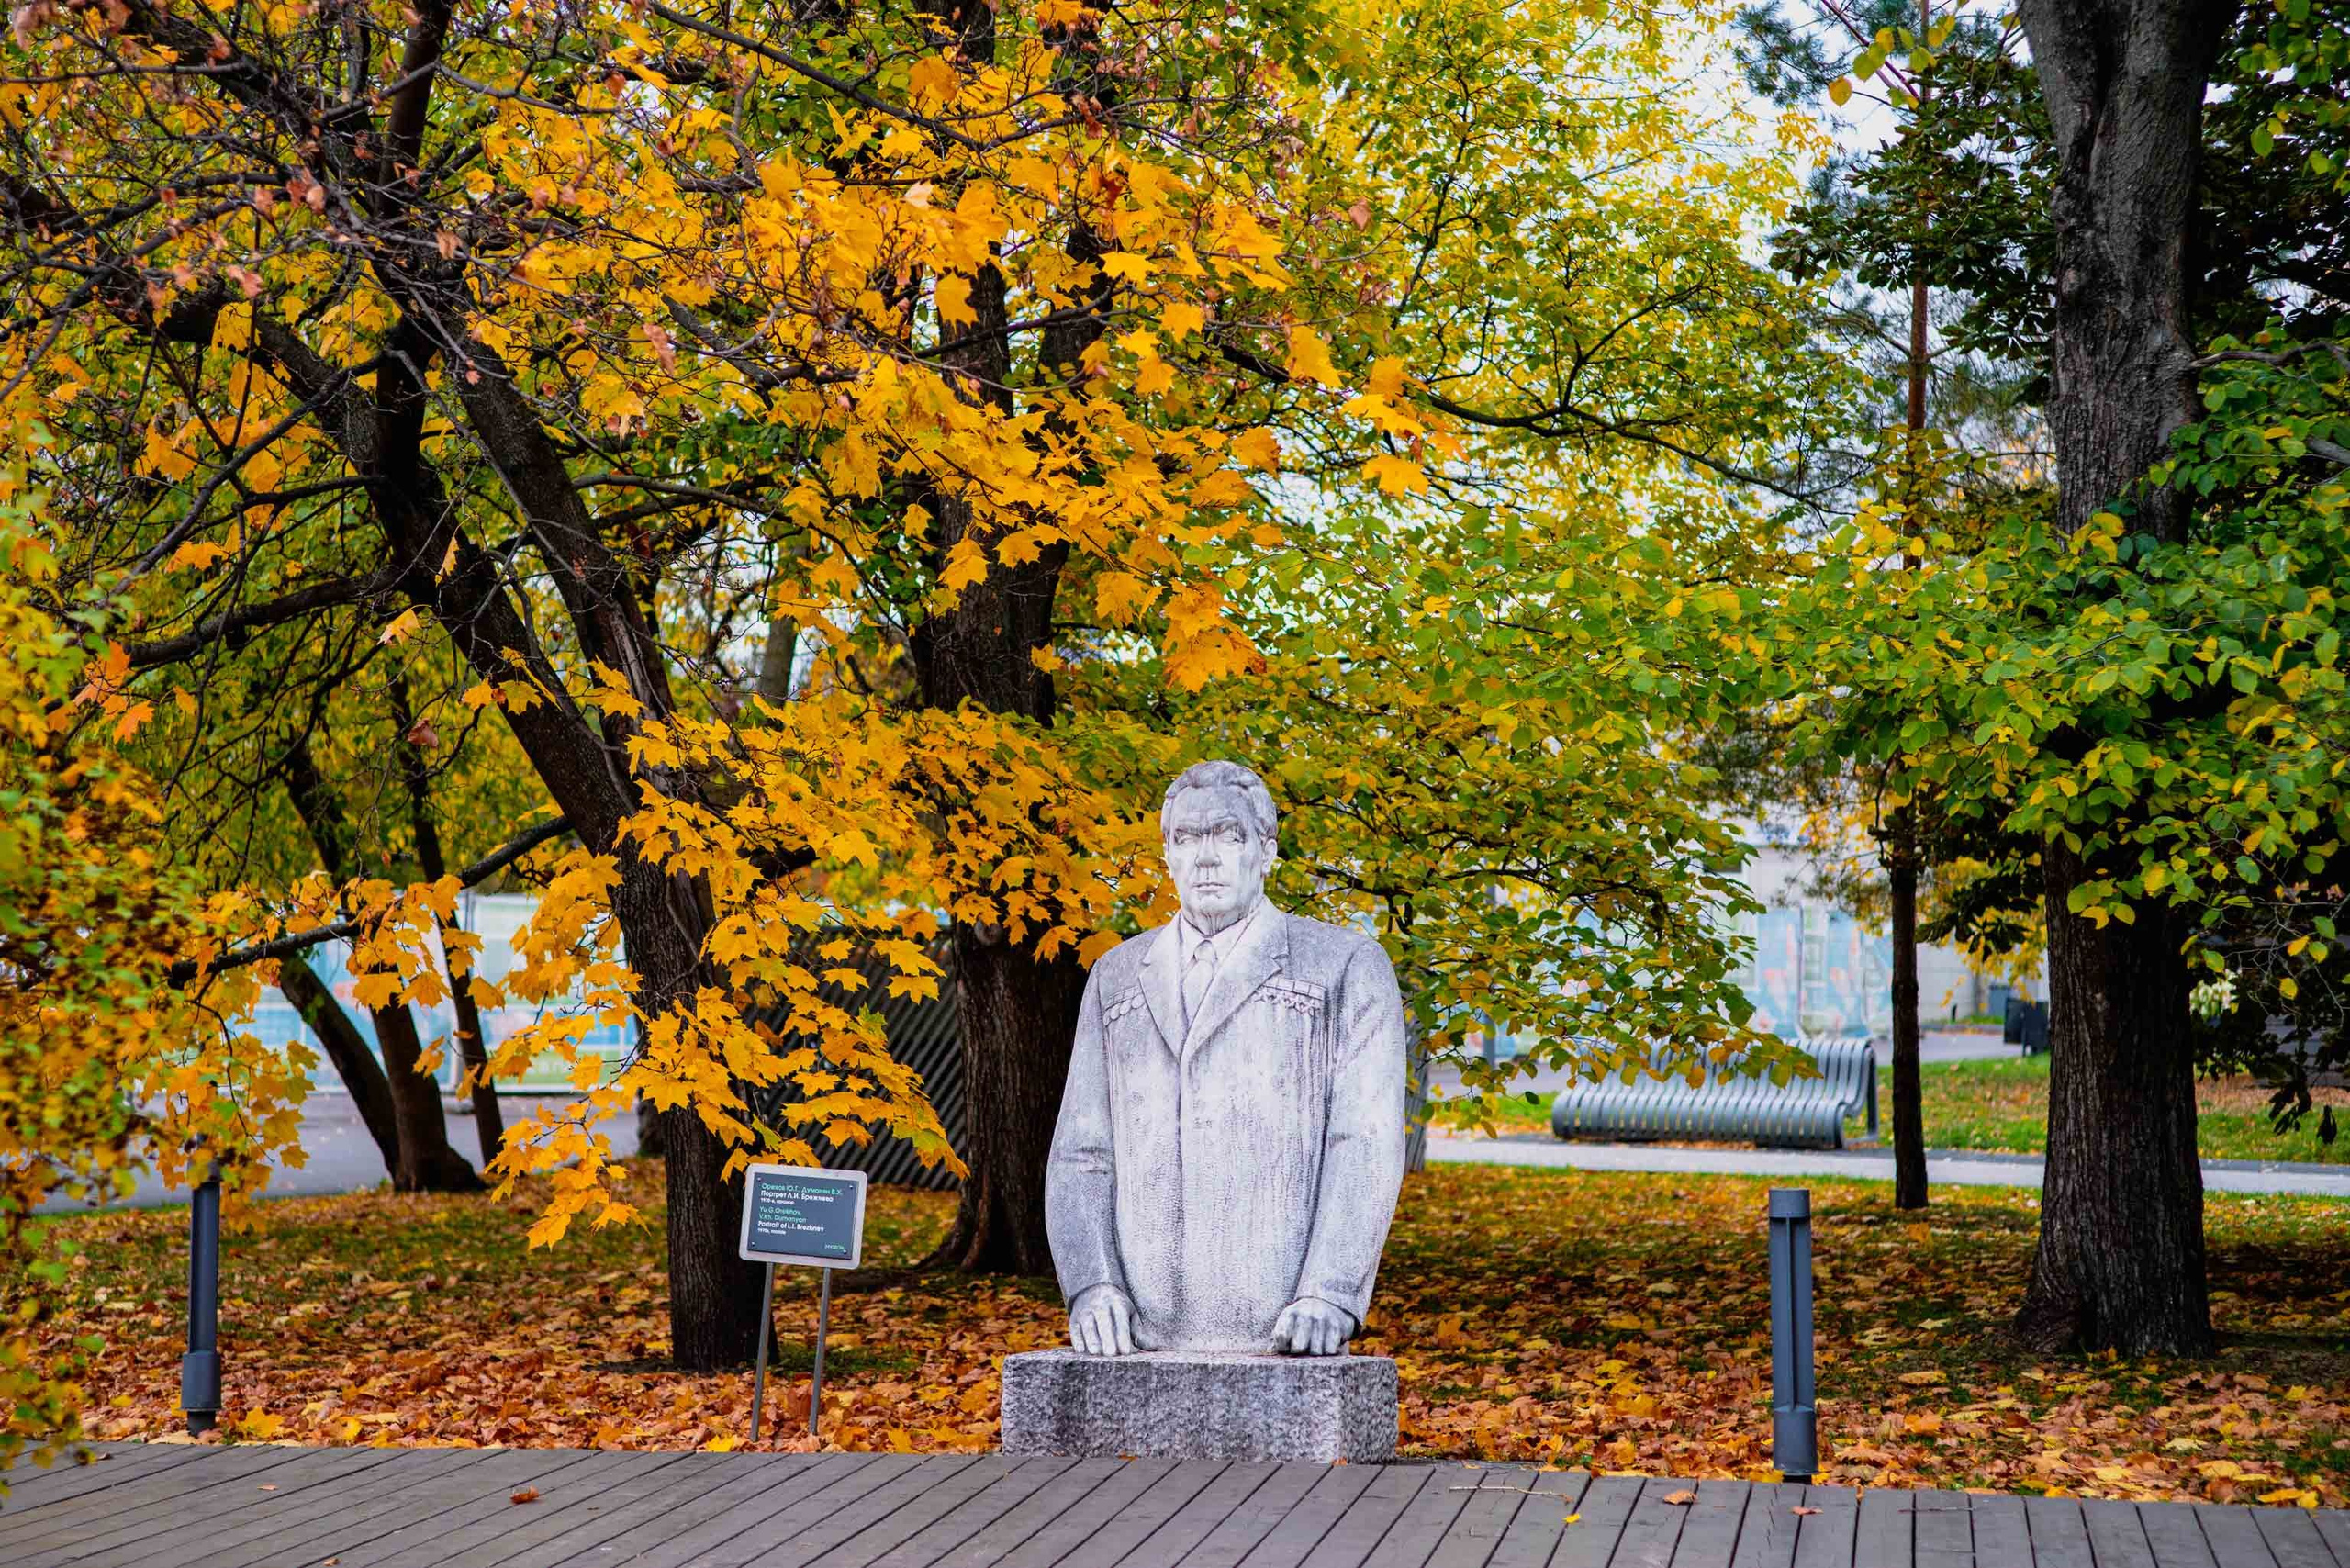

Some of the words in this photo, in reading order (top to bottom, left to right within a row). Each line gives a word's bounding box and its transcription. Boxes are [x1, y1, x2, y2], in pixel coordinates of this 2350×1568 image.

[760, 1190, 786, 1198] Портрет
[801, 1193, 834, 1202] Брежнева
[774, 1215, 807, 1223] Dumanyan
[758, 1220, 779, 1228] Portrait
[797, 1224, 824, 1232] Brezhnev
